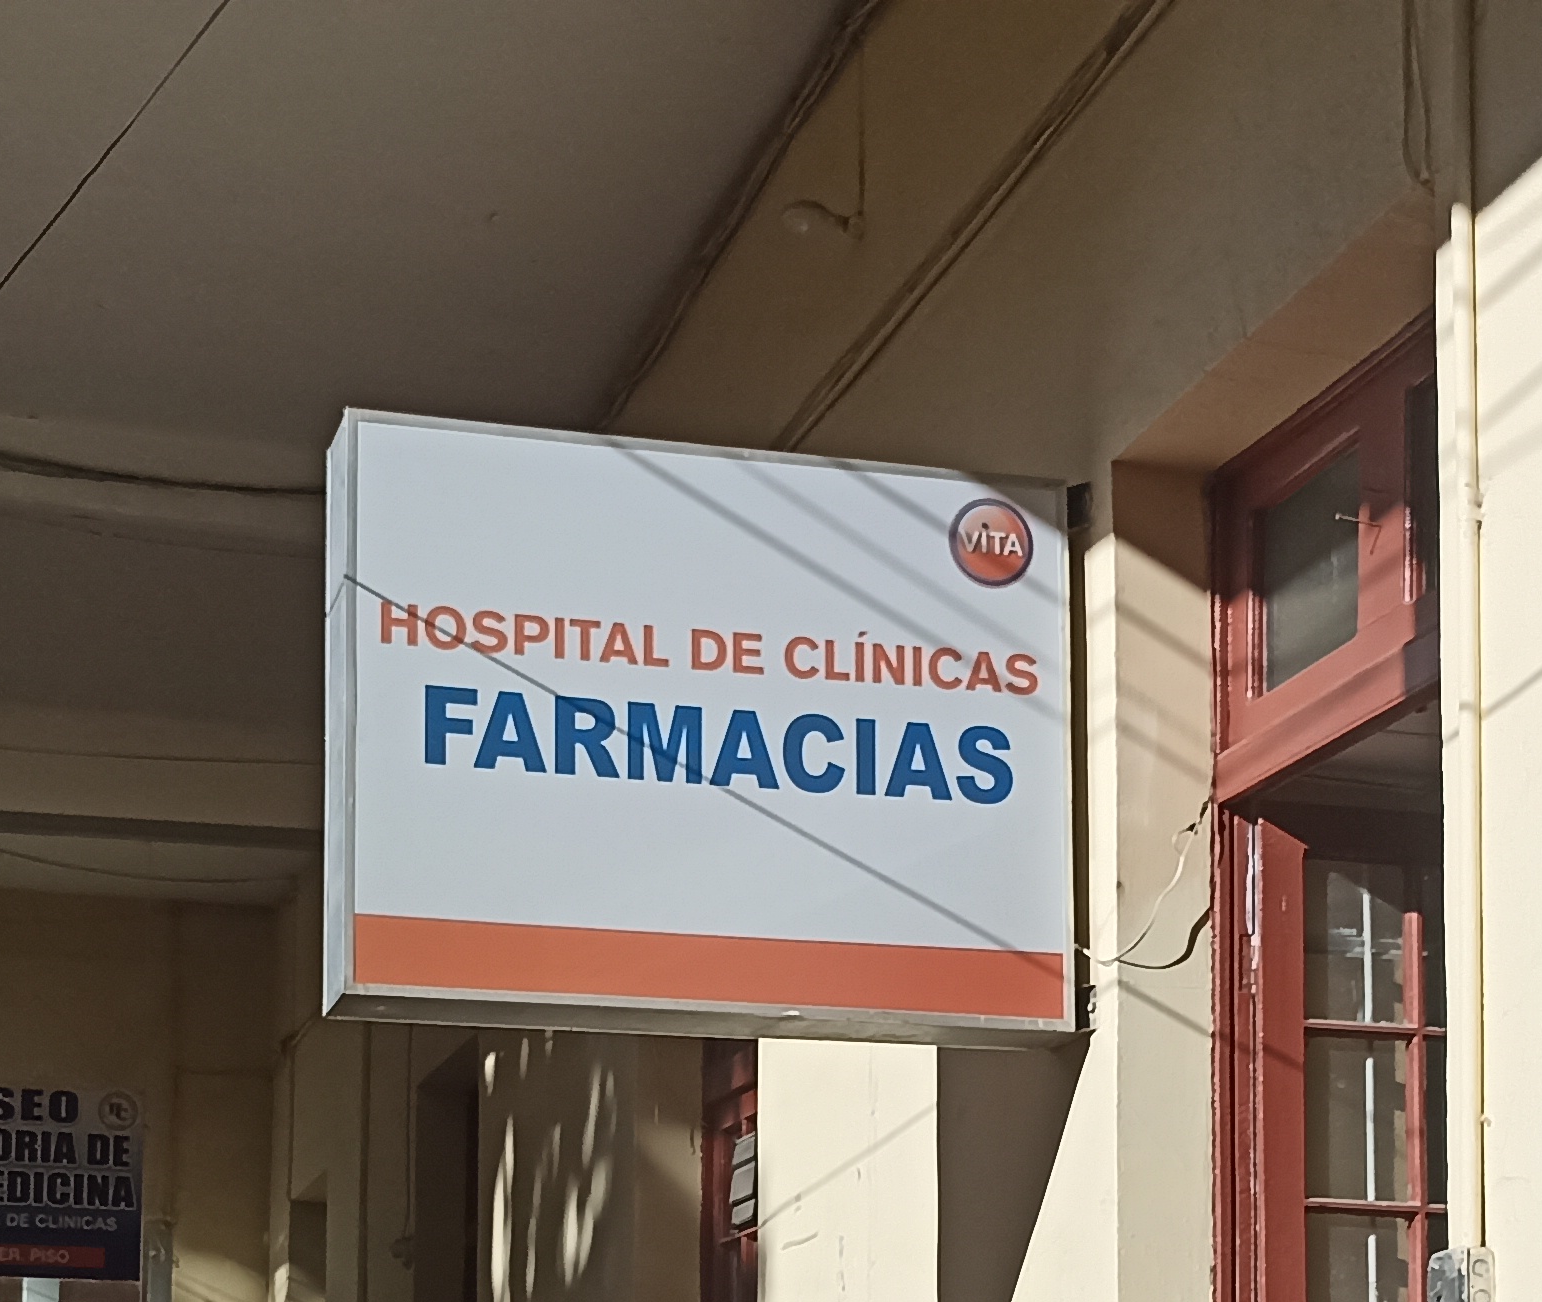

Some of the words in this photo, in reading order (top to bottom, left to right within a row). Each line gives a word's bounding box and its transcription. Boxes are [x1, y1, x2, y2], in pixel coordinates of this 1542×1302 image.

[379, 600, 670, 669] HOSPITAL
[690, 628, 764, 675] DE
[783, 630, 1040, 696] CLÍNICAS
[423, 684, 1015, 805] FARMACIAS
[87, 1133, 130, 1167] DE
[6, 1213, 30, 1228] DE
[35, 1214, 118, 1231] CLINICAS
[30, 1248, 70, 1264] PISO
